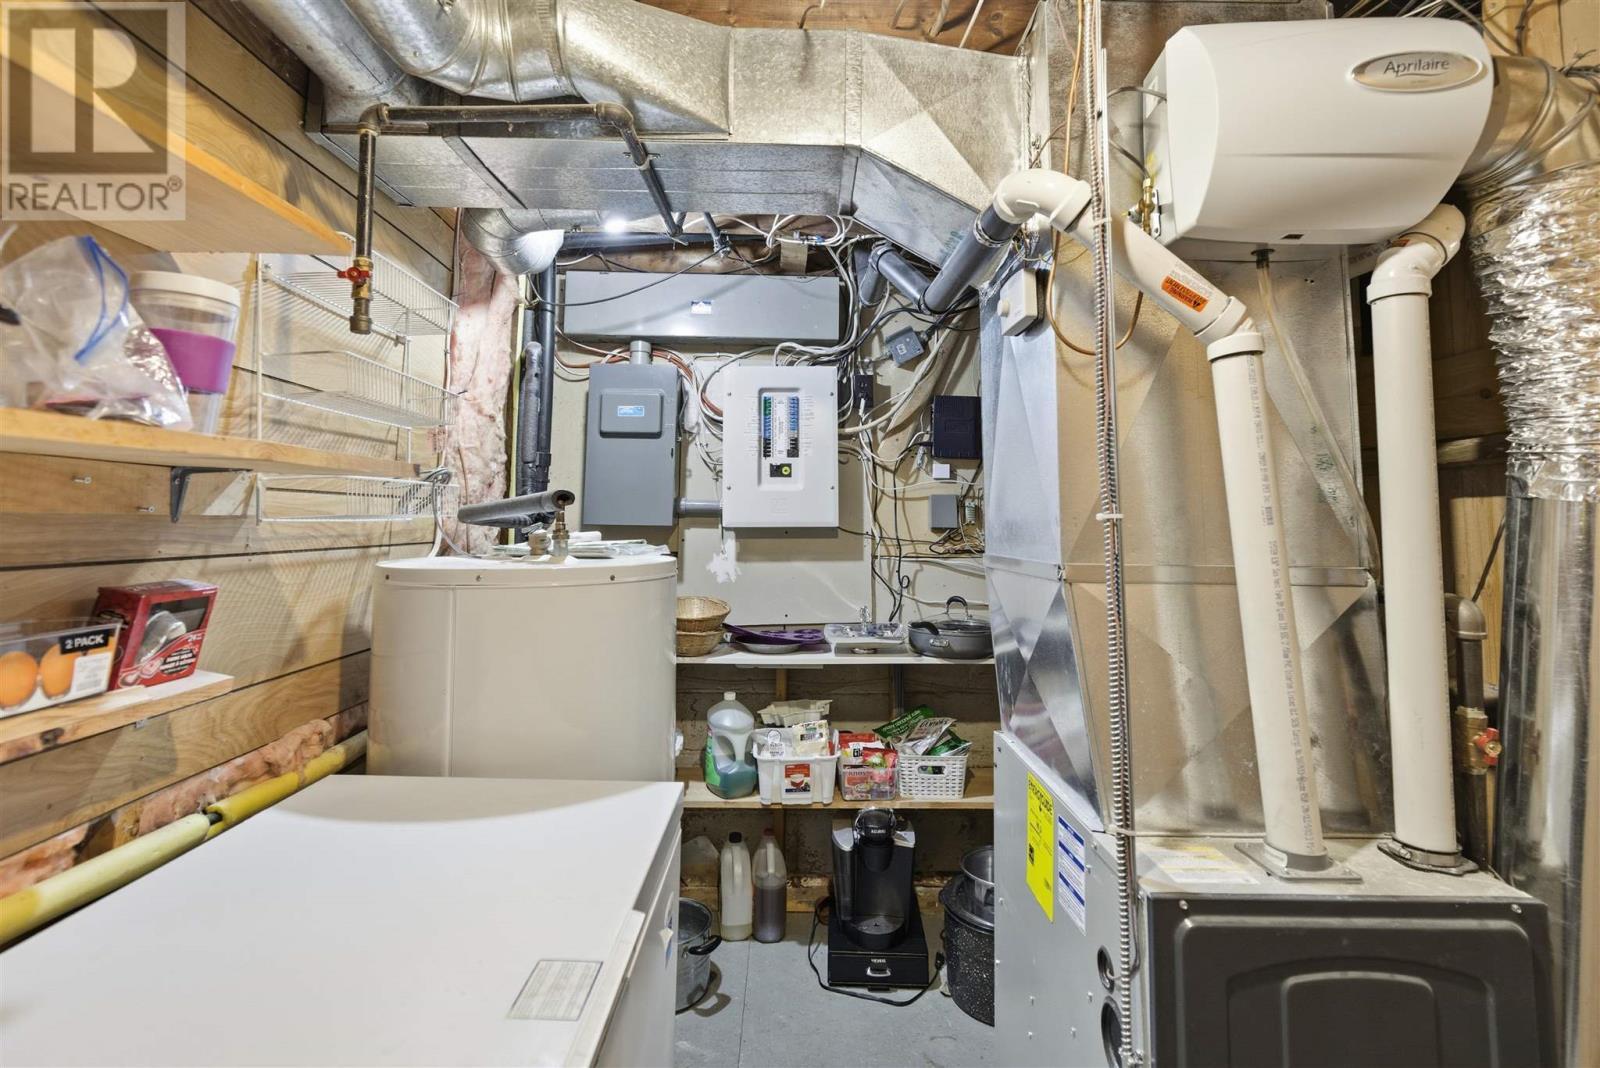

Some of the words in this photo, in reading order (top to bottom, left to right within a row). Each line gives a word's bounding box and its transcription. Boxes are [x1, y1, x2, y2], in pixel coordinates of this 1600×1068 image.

[1383, 59, 1451, 77] Aprilaire
[65, 639, 73, 650] 2
[74, 634, 105, 648] PACK
